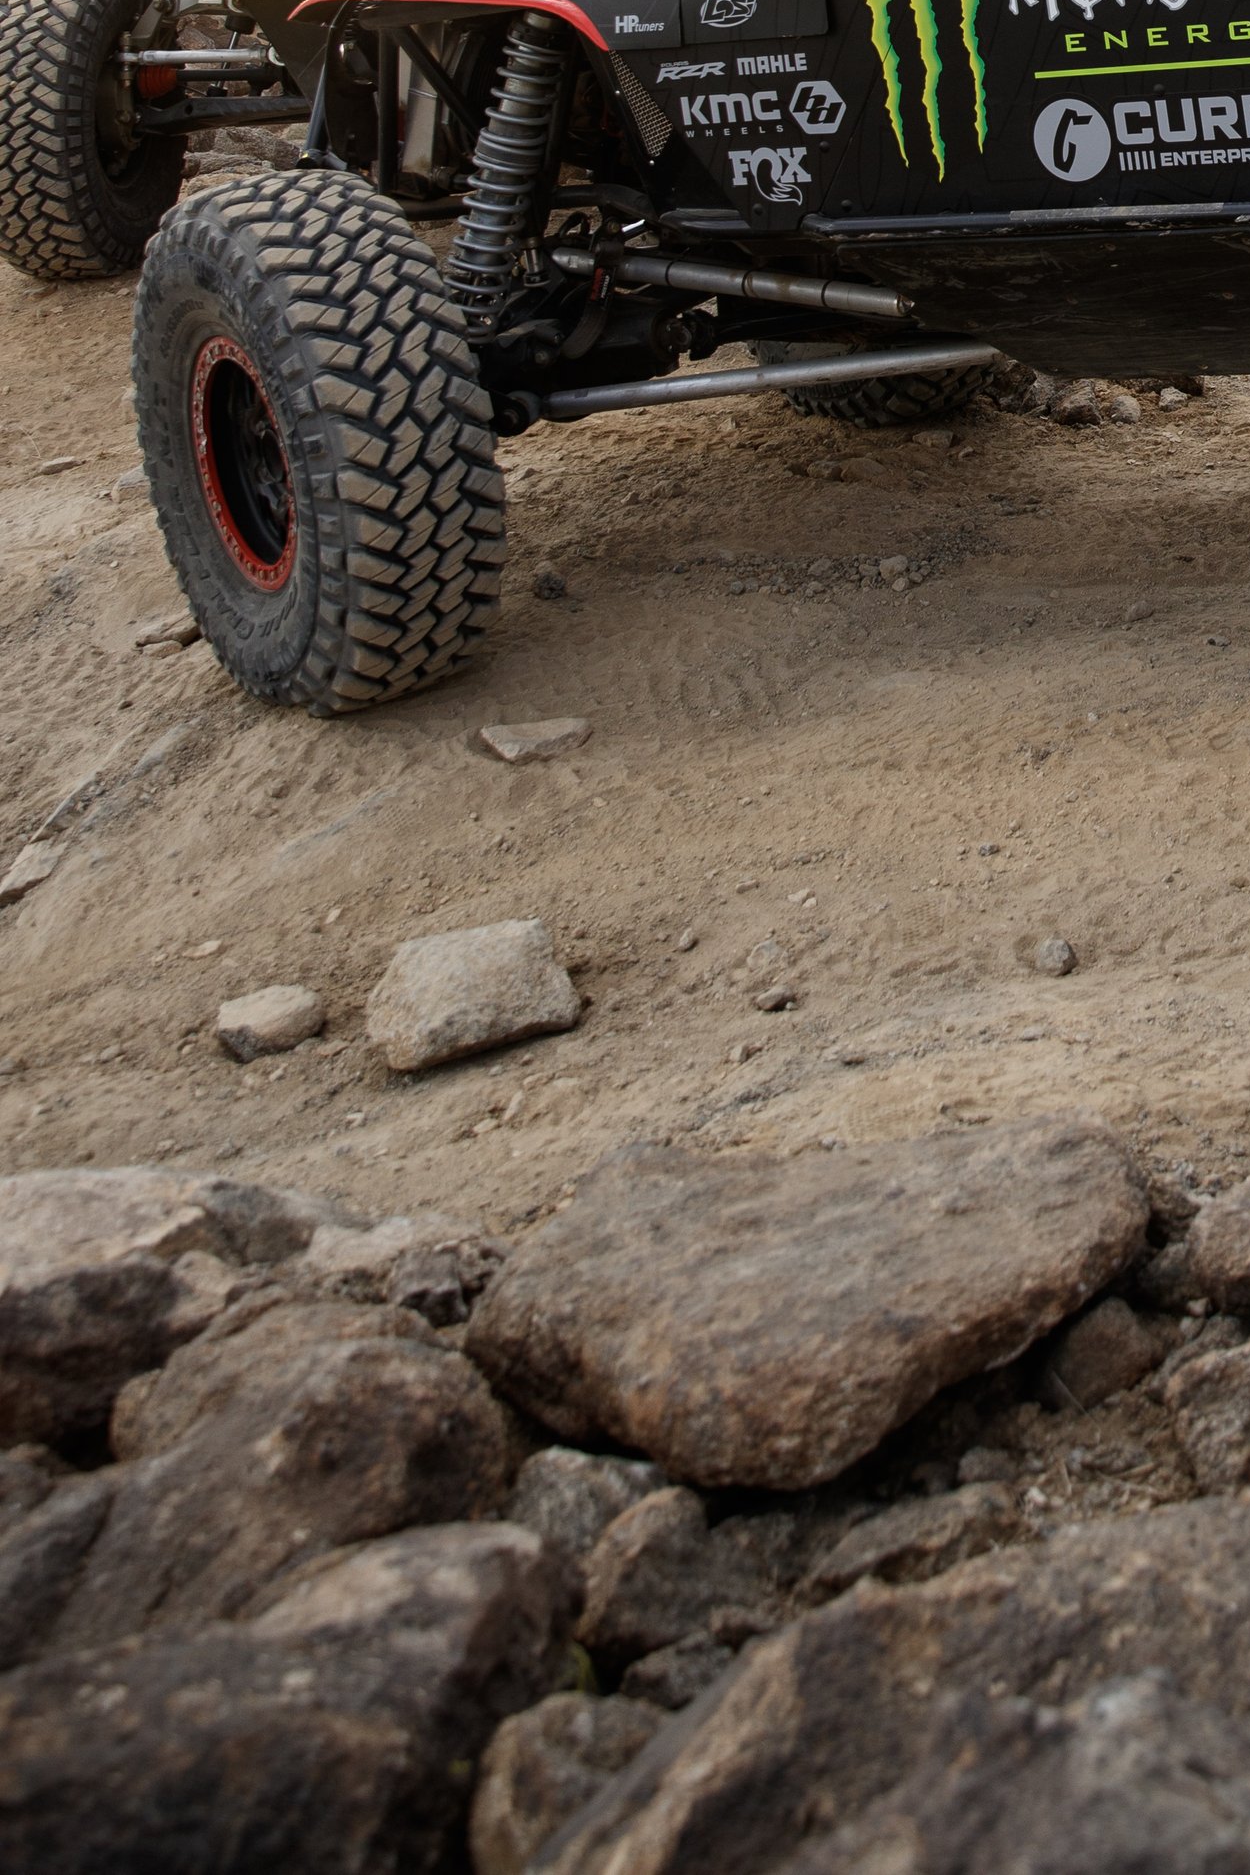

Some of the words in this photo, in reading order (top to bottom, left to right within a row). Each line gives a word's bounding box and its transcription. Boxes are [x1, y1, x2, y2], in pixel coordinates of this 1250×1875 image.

[655, 62, 727, 84] RZR
[736, 53, 808, 76] MAHLE
[685, 125, 785, 139] WHEELS
[728, 146, 812, 187] FOX
